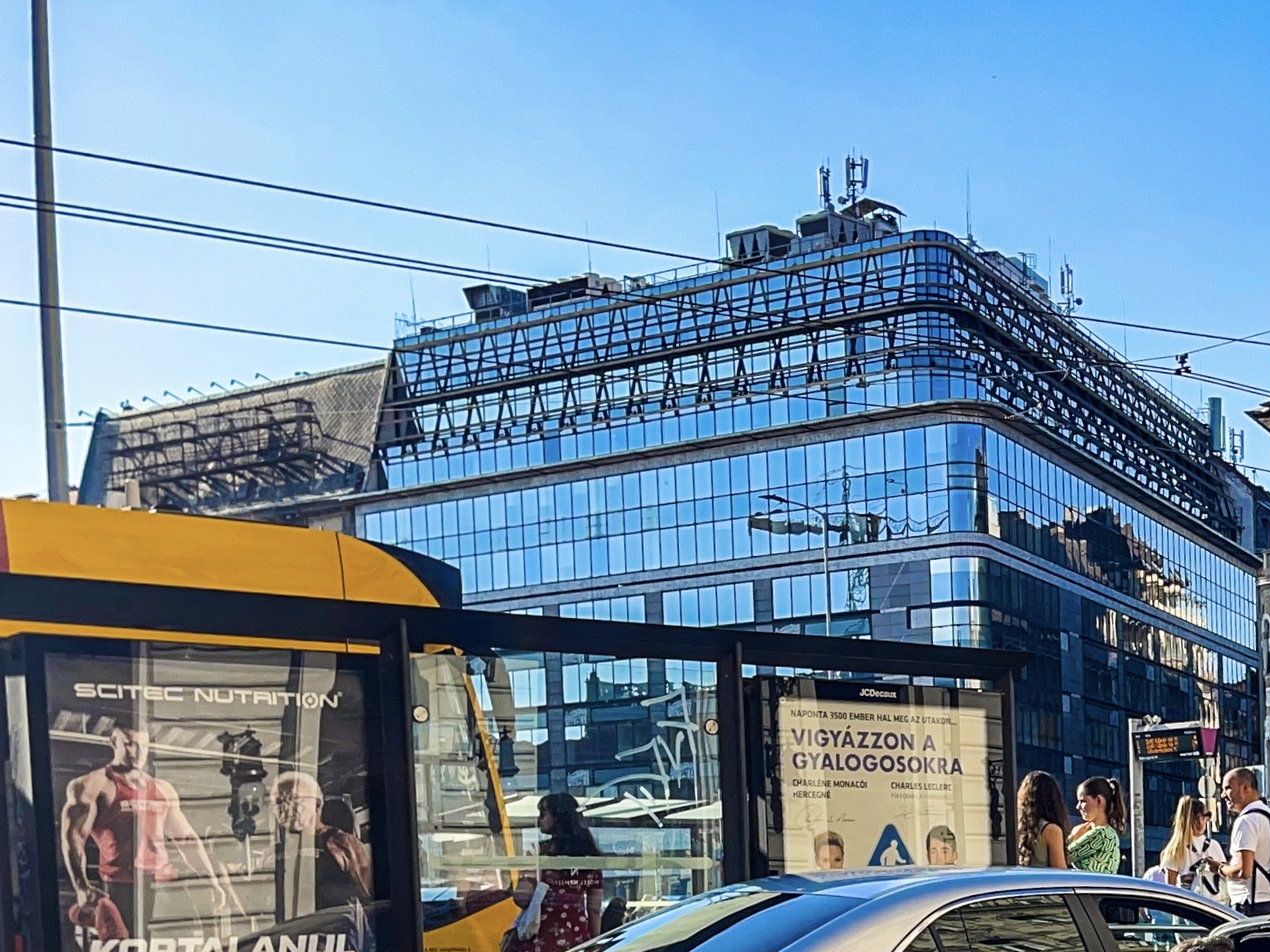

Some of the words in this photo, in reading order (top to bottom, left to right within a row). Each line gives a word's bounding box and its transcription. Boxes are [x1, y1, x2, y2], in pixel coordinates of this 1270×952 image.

[74, 682, 184, 701] SCITEC
[194, 687, 339, 709] NUTRITION
[859, 688, 897, 699] JCDecaux
[790, 709, 829, 719] NAPONTA
[830, 711, 848, 720] 3500
[849, 712, 875, 721] EMBER
[877, 713, 892, 722] HAL
[893, 714, 909, 723] MEG
[910, 715, 920, 724] AZ
[791, 725, 915, 751] VIGYÁZZON
[922, 734, 937, 752] A
[792, 752, 964, 776] GYALOGOSOKRA
[833, 779, 868, 790] MONACÓI
[890, 781, 923, 790] CHARLES
[923, 783, 952, 792] LECLERC
